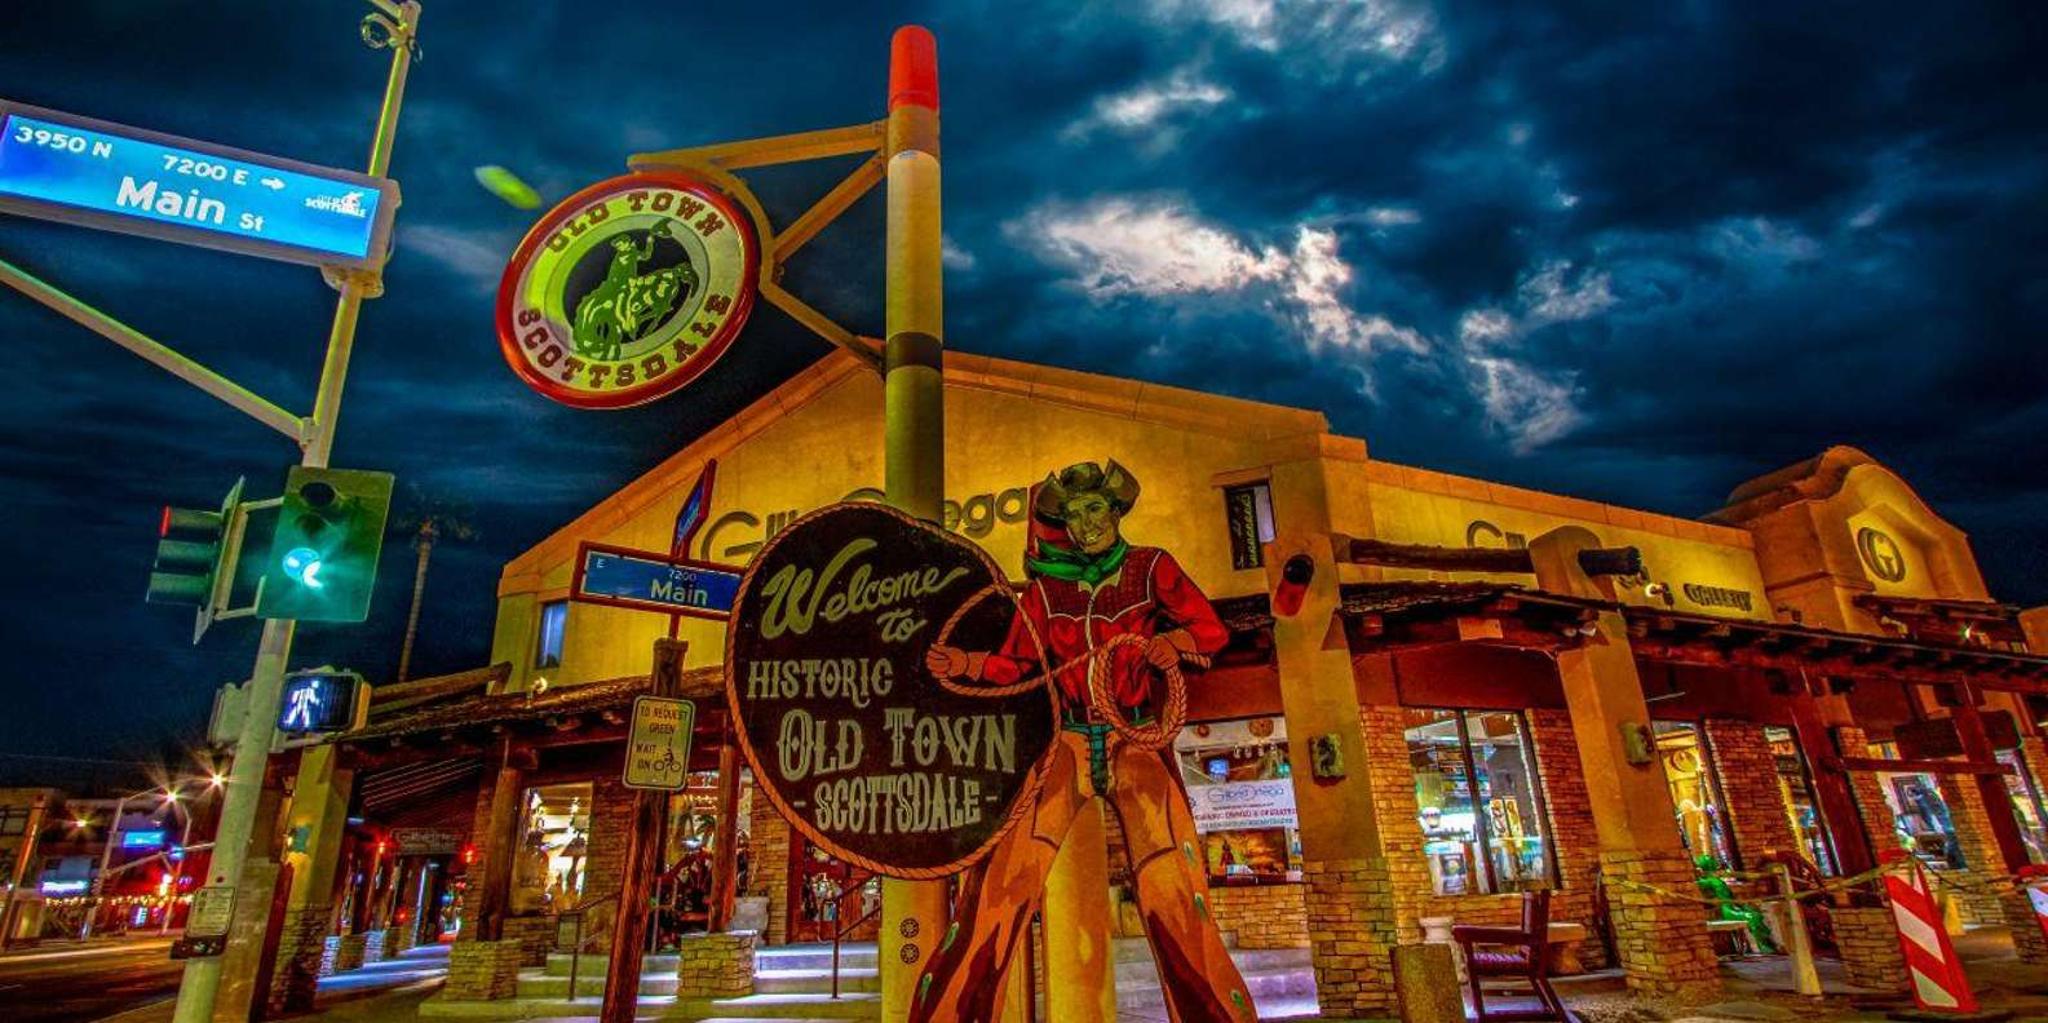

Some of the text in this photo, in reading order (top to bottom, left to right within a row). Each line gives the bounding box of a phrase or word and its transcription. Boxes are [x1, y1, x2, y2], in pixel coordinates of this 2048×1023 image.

[15, 126, 113, 159] 3950 N
[163, 154, 249, 186] 7200 E
[115, 175, 264, 233] Main St
[546, 192, 726, 253] OLD TOWN
[517, 293, 733, 389] SCOTTSDALE
[596, 558, 608, 569] E
[667, 568, 698, 582] 7200
[761, 538, 970, 639] Welcome
[650, 578, 709, 607] Main
[876, 608, 928, 643] to
[746, 657, 894, 708] HISTORIC
[777, 707, 1017, 782] OLD TOWN
[813, 773, 982, 835] SCOTTSDALE
